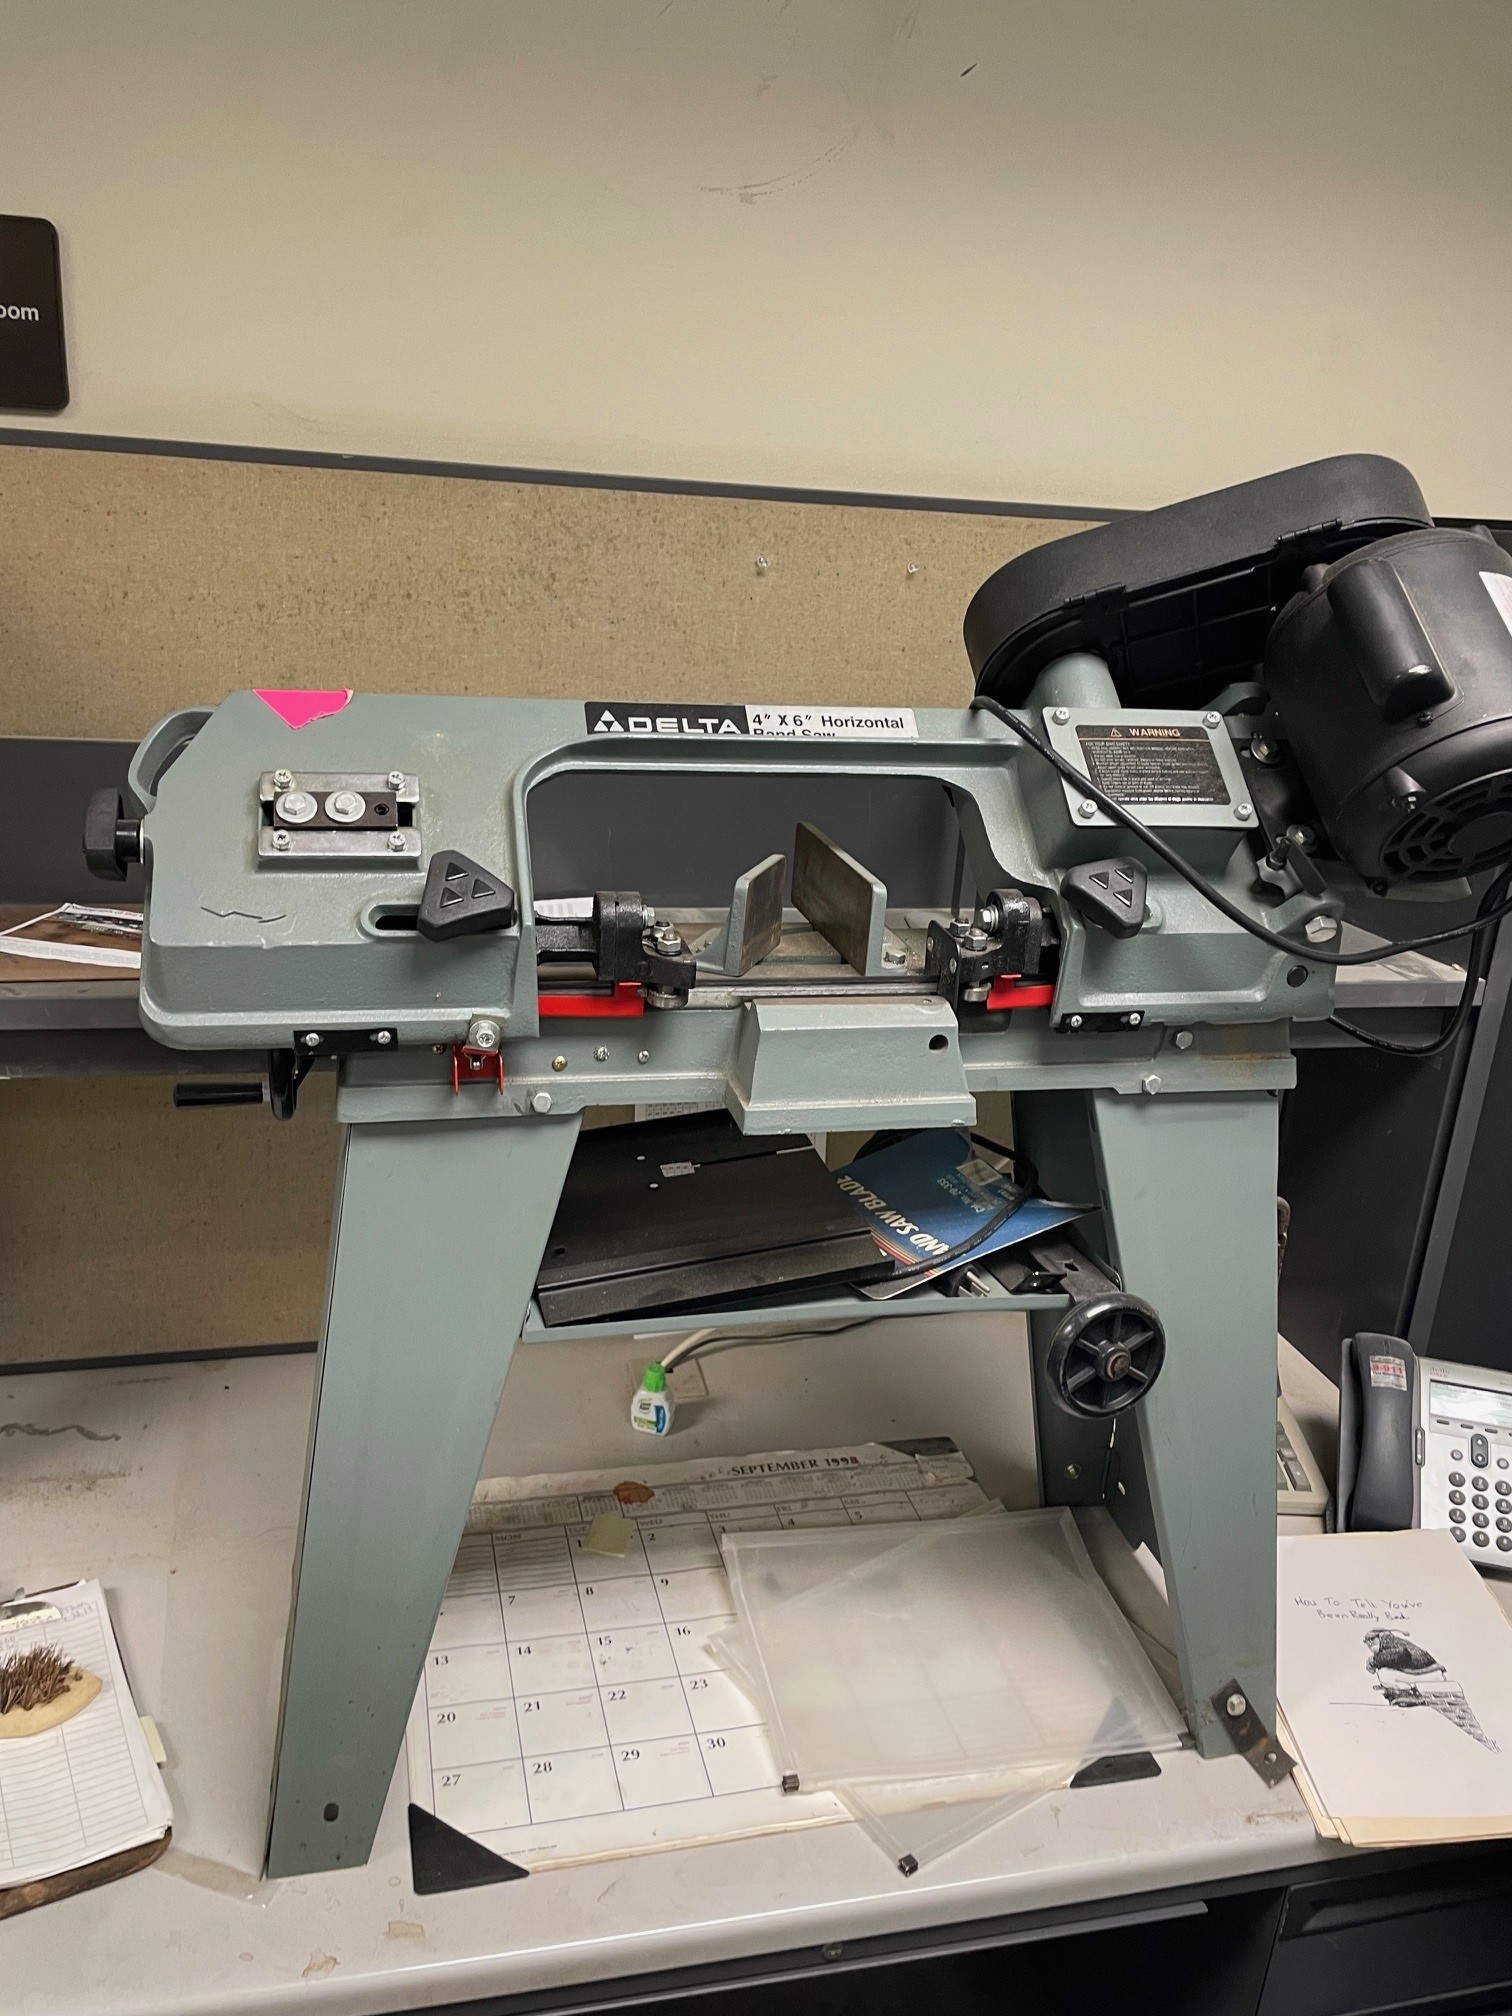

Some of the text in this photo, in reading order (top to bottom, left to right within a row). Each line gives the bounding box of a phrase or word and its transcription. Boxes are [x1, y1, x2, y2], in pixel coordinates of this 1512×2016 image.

[0, 304, 39, 321] oom
[627, 716, 742, 734] DELTA
[752, 714, 904, 729] 4" X 6" Horizontal
[753, 728, 796, 736] Band
[1129, 728, 1181, 737] WARNING
[875, 1210, 919, 1235] SAW
[909, 1233, 950, 1255] AND
[731, 1458, 819, 1476] SEPTEMBER
[648, 1533, 656, 1542] 2
[508, 1578, 669, 1605] 7 8 9
[1294, 1596, 1423, 1609] How To Tell You've
[1316, 1609, 1349, 1618] Been
[1349, 1610, 1380, 1622] Really
[434, 1626, 691, 1666] 13 14 15 16
[436, 1679, 708, 1724] 20 21 22 23
[441, 1737, 726, 1787] 27 28 29 30
